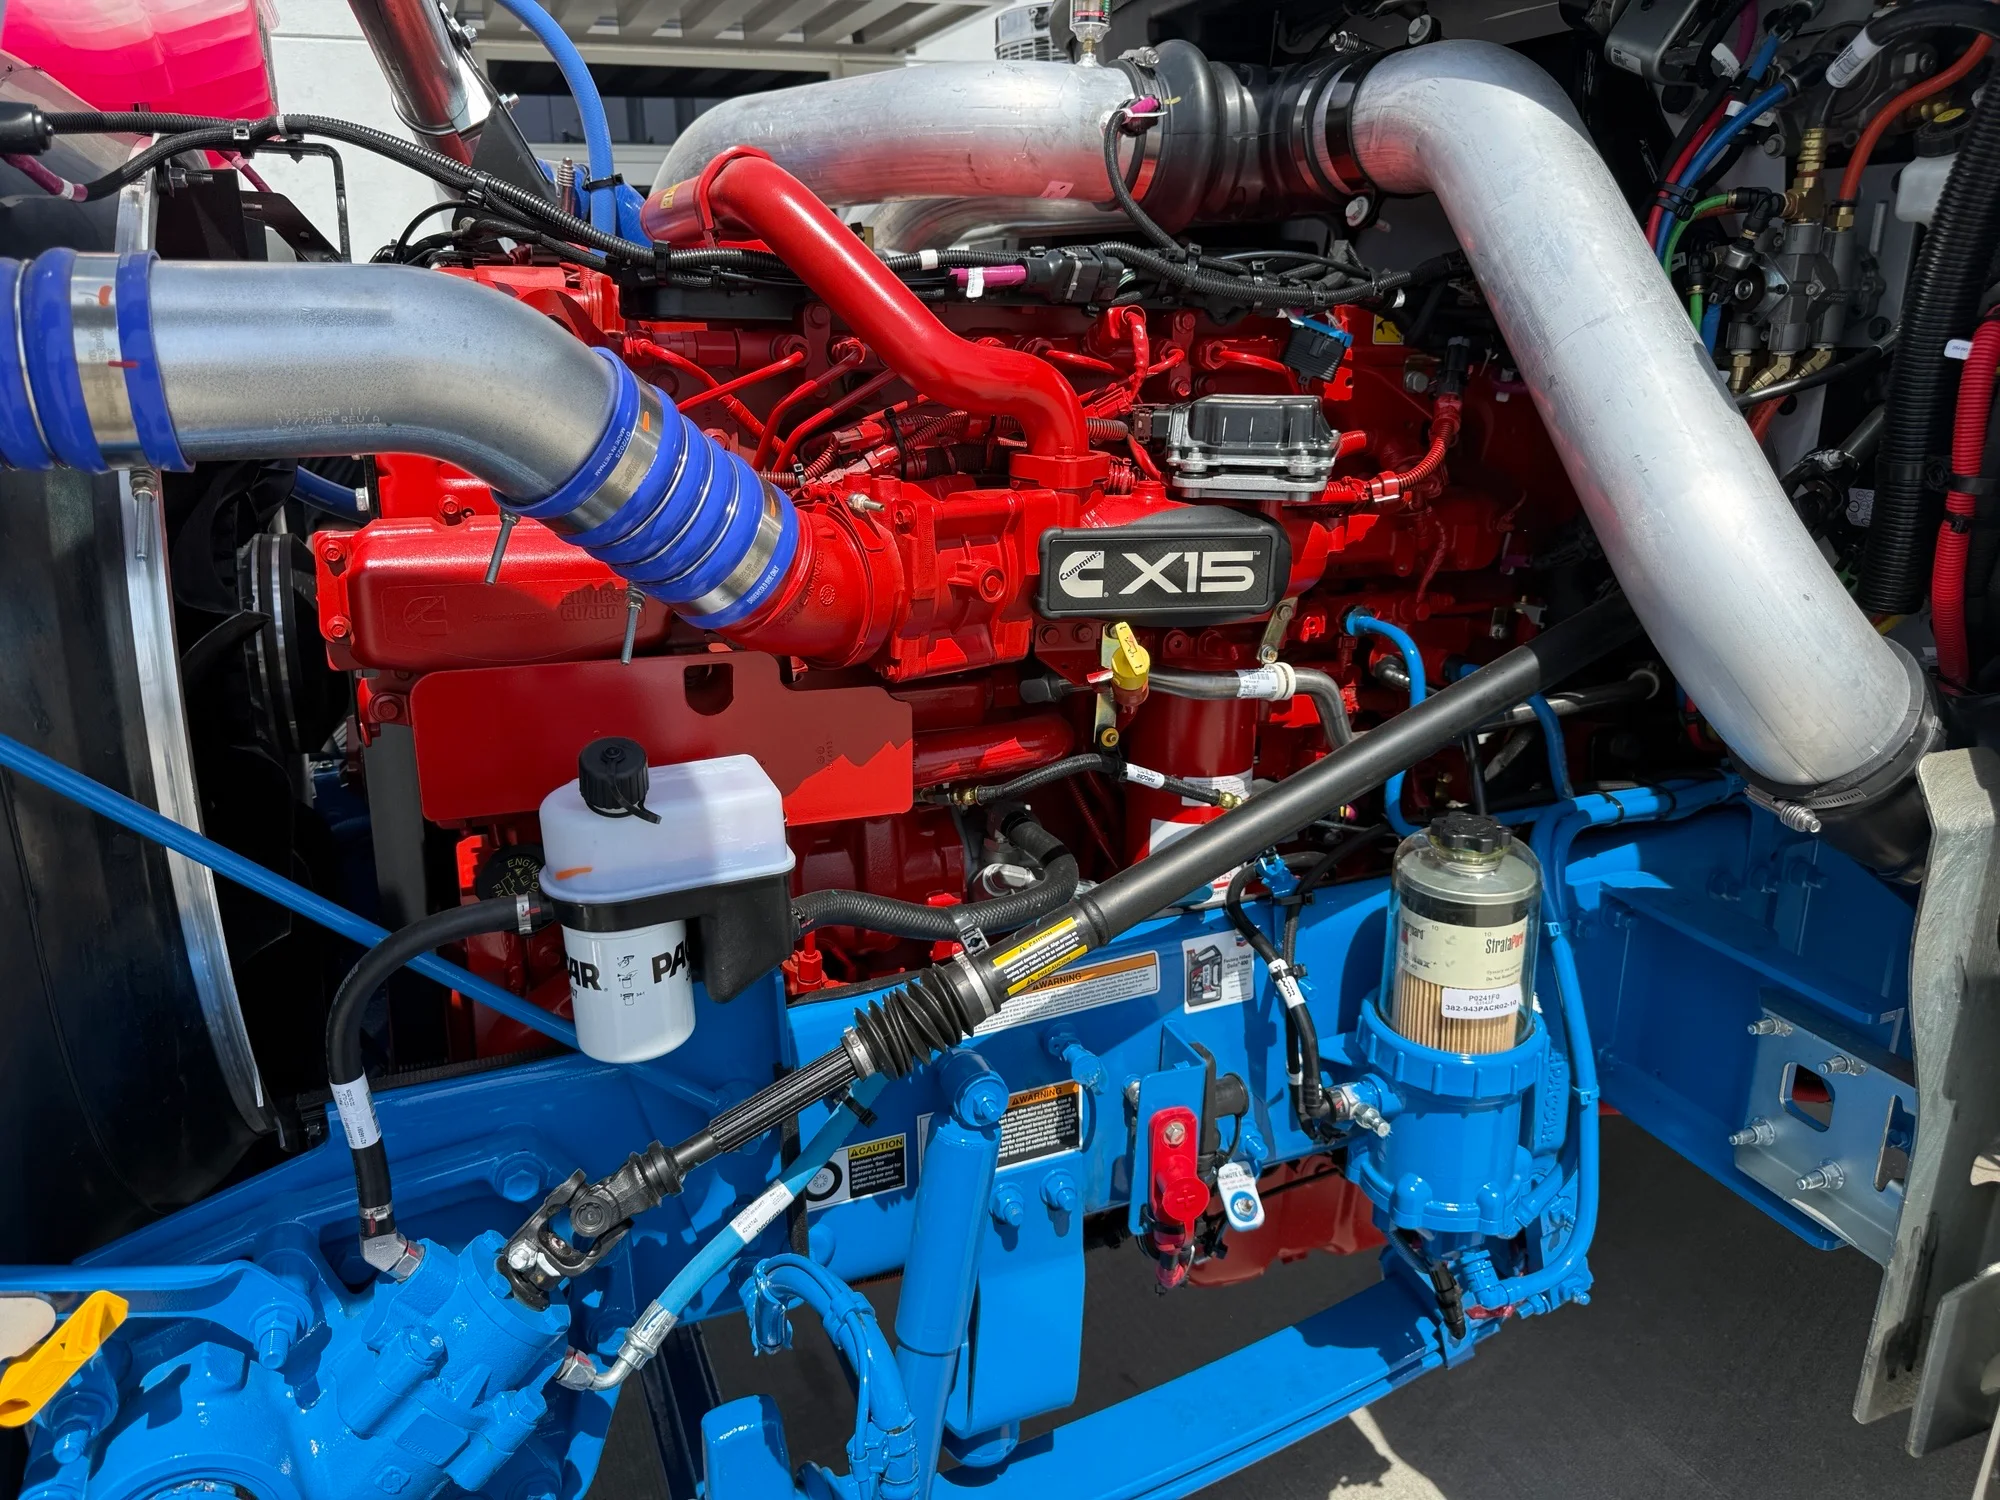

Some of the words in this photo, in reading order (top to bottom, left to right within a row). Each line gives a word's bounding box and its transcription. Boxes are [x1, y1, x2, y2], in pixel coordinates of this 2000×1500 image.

[616, 427, 626, 446] MADE
[611, 444, 618, 453] IN
[595, 452, 614, 477] VIETNAM
[1060, 551, 1101, 581] Cummins
[1118, 551, 1255, 595] X15
[507, 858, 540, 880] ENGINE
[566, 954, 602, 991] AR
[1040, 972, 1080, 988] WARNING
[1020, 1087, 1061, 1103] WARNING
[859, 1138, 901, 1154] CAUTION
